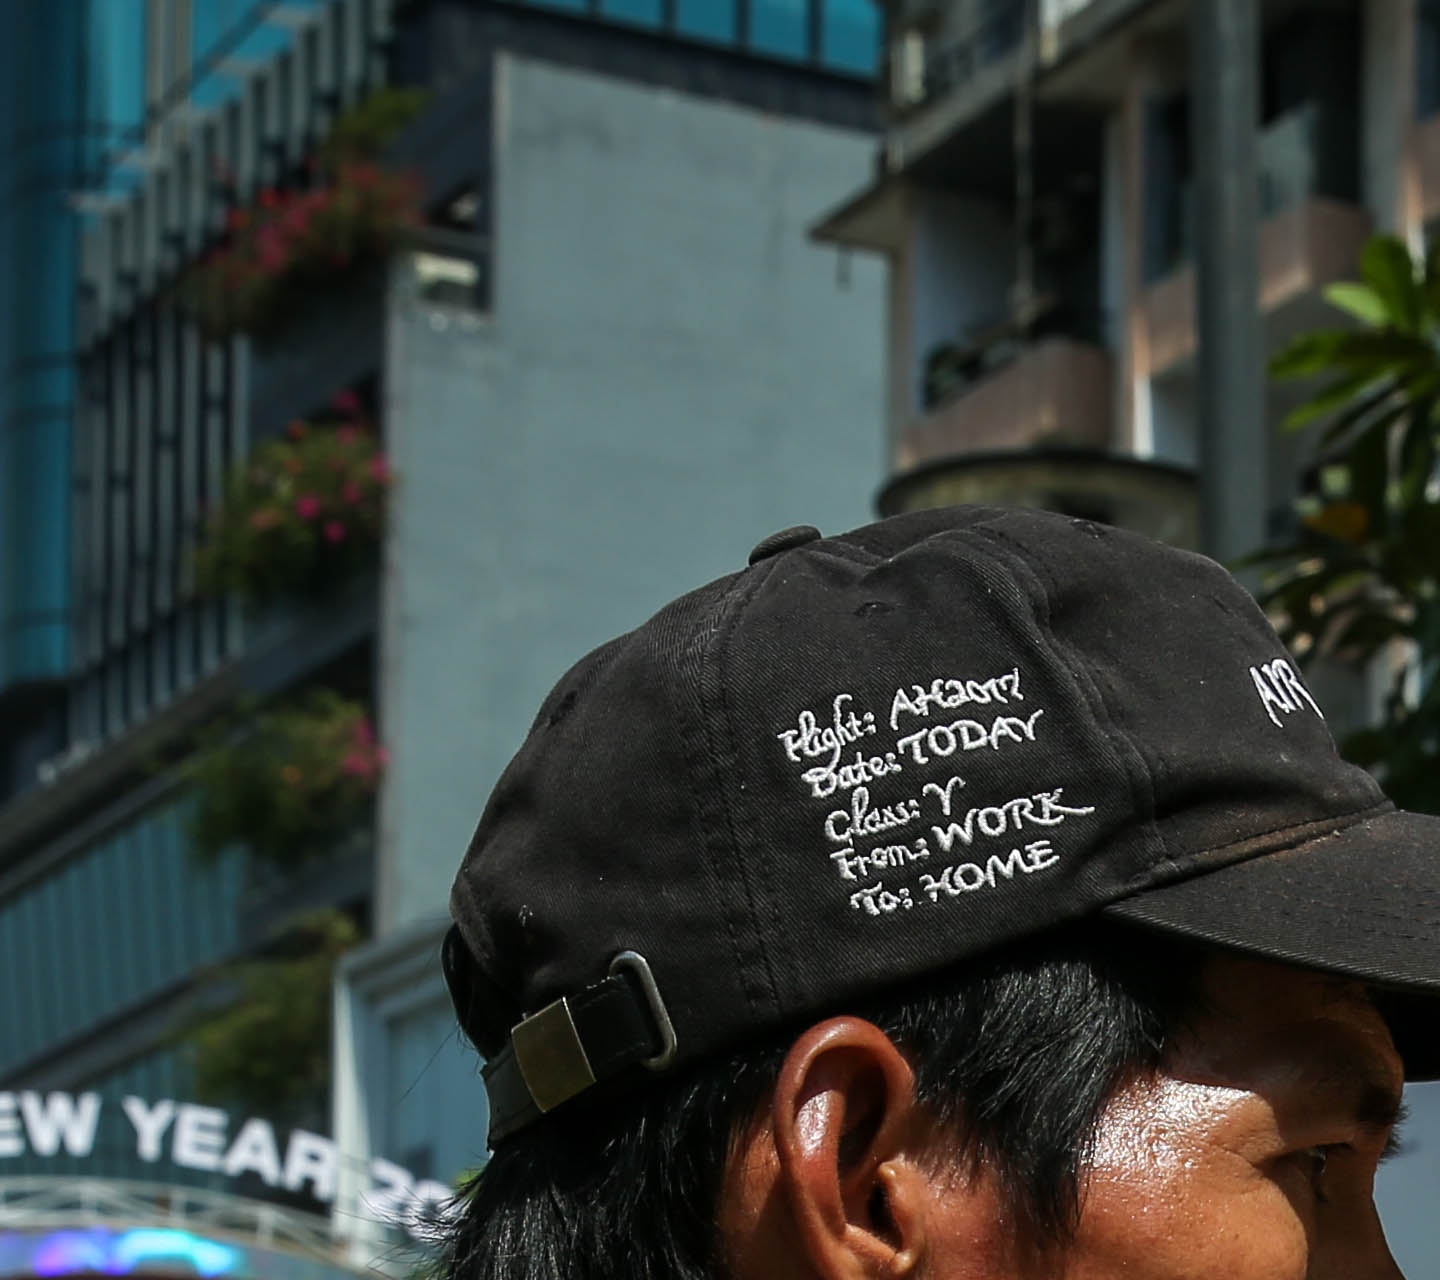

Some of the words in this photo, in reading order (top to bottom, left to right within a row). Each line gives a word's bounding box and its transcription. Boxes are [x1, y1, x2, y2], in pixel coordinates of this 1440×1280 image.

[1249, 658, 1325, 728] AIR
[801, 752, 903, 798] Date:
[896, 708, 1045, 765] TODAY
[824, 786, 921, 843] Class:
[922, 776, 967, 817] Y
[829, 838, 931, 882] From:
[931, 787, 1096, 852] WORK
[850, 880, 914, 916] To:
[918, 840, 1060, 903] HOME
[121, 1095, 338, 1202] YEAR
